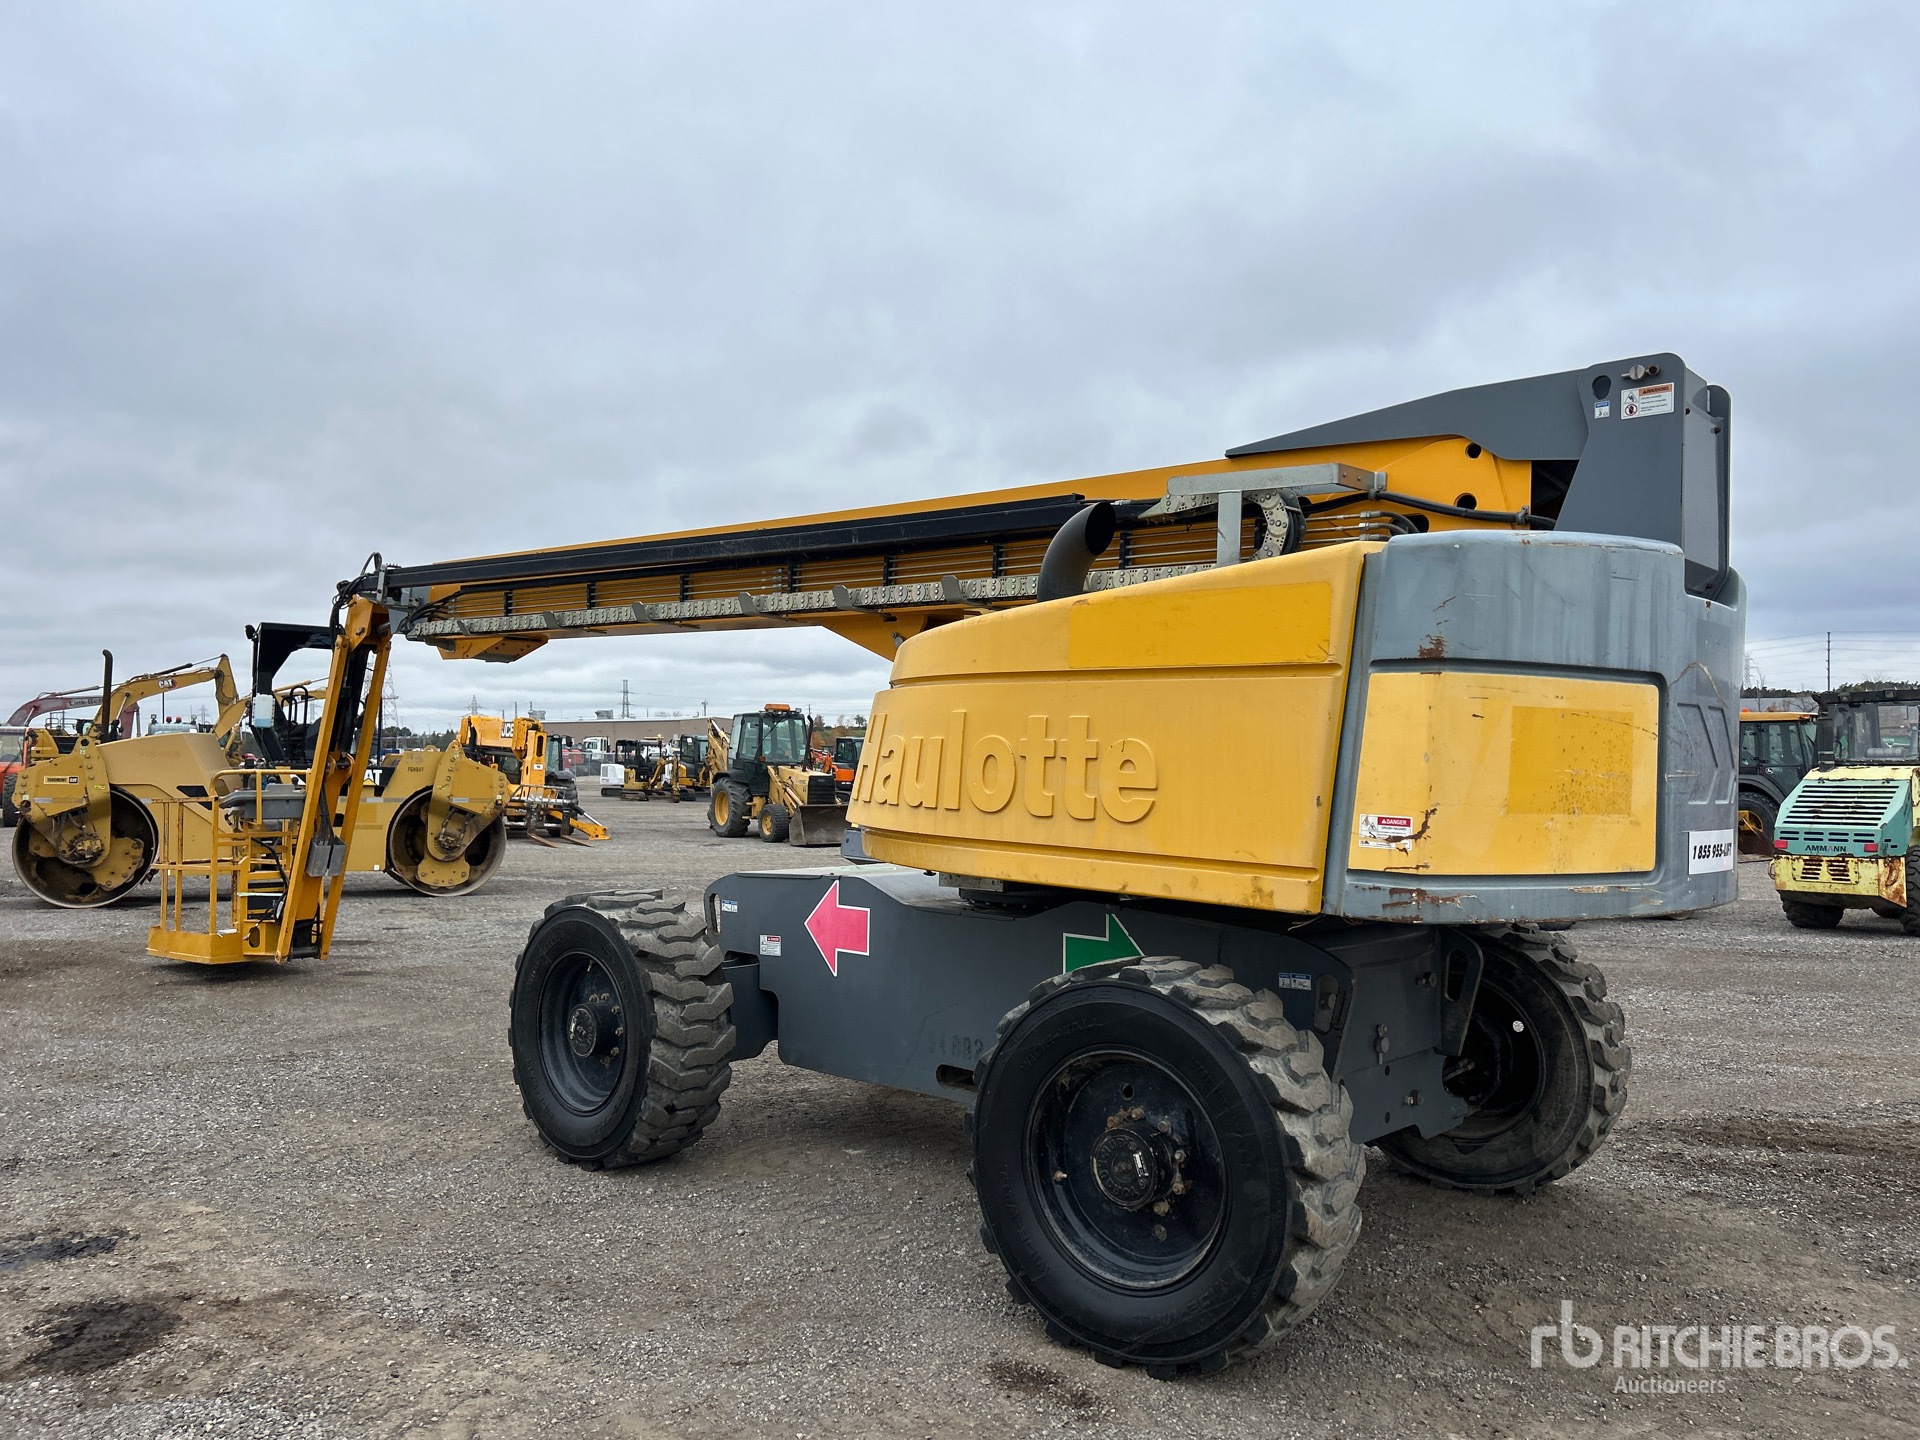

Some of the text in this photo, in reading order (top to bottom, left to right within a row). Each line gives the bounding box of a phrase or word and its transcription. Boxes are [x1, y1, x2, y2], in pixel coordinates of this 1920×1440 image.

[158, 678, 174, 688] CAT
[69, 698, 102, 706] Link-Bel
[851, 709, 1159, 823] Haulotte
[363, 769, 383, 786] AT
[1386, 818, 1408, 826] DANGER
[1692, 845, 1698, 860] 1
[1697, 844, 1711, 860] 855
[1804, 844, 1847, 852] AMMANN
